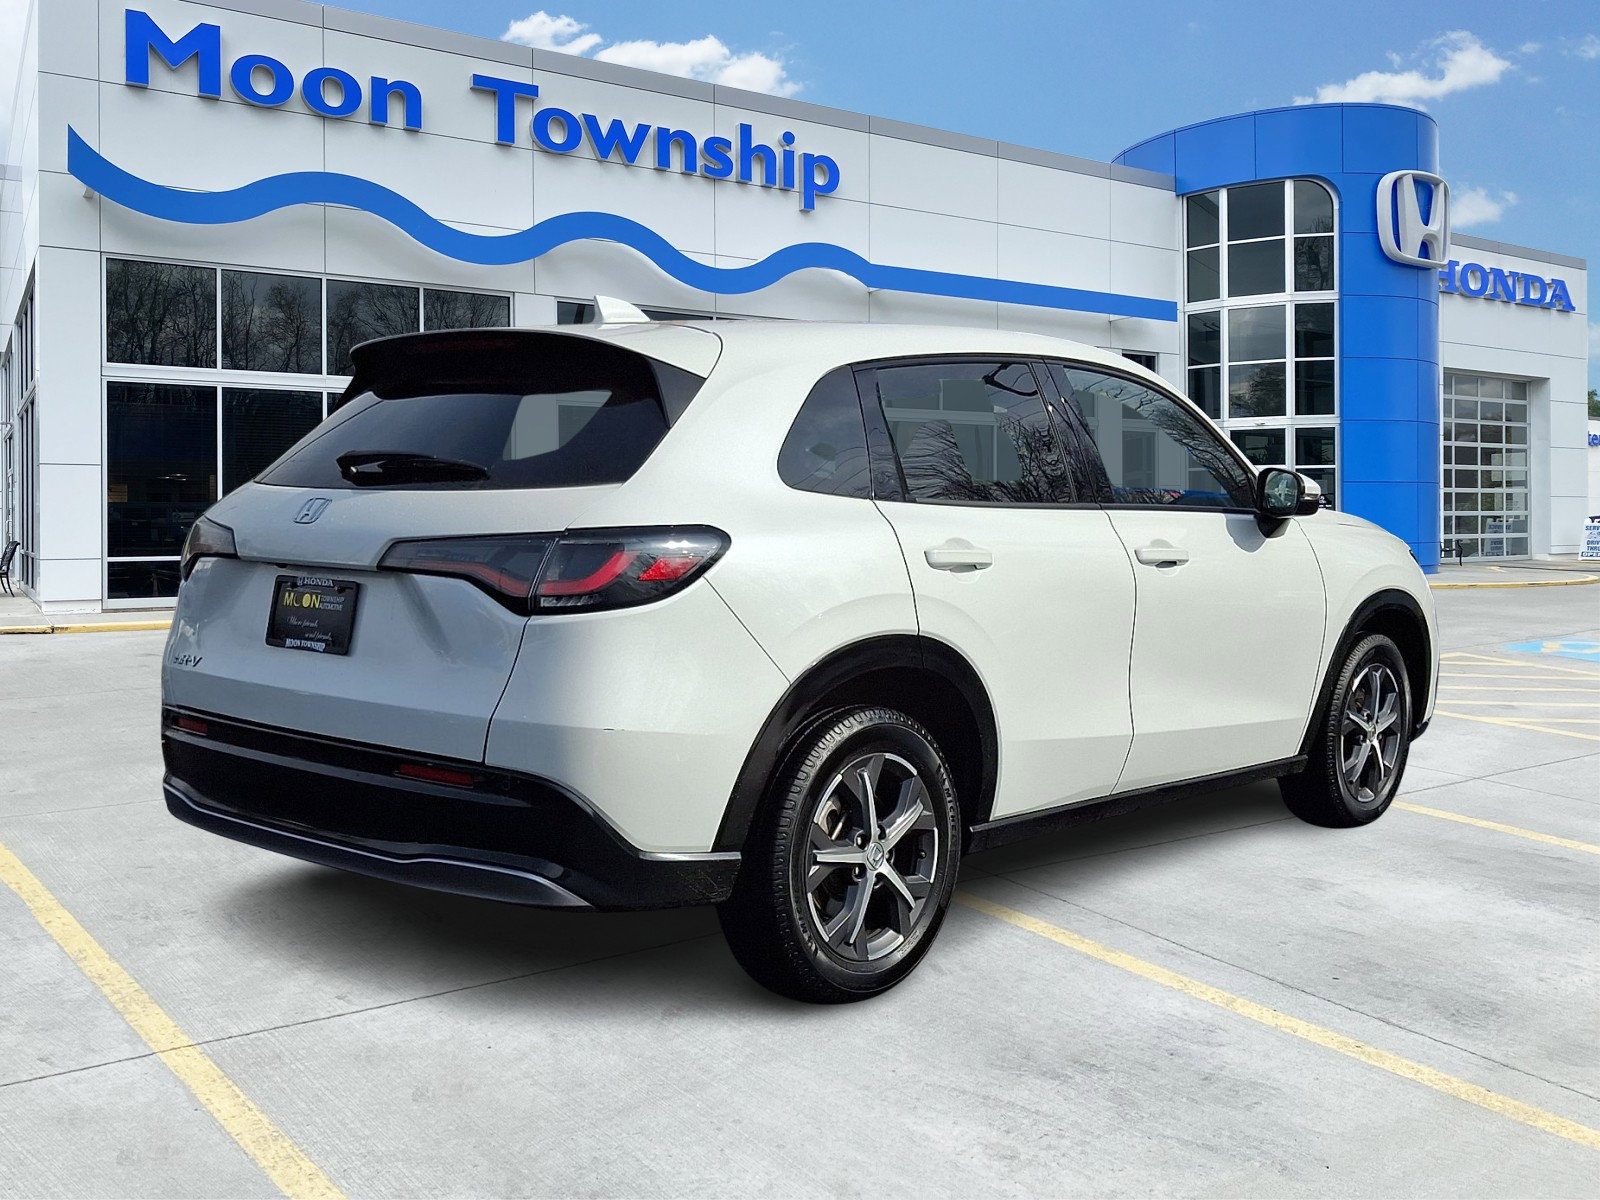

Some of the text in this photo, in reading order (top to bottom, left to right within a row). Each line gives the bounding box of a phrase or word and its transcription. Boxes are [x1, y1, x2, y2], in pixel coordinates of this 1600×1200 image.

[124, 8, 840, 213] Moon Township
[304, 577, 334, 587] HONDA
